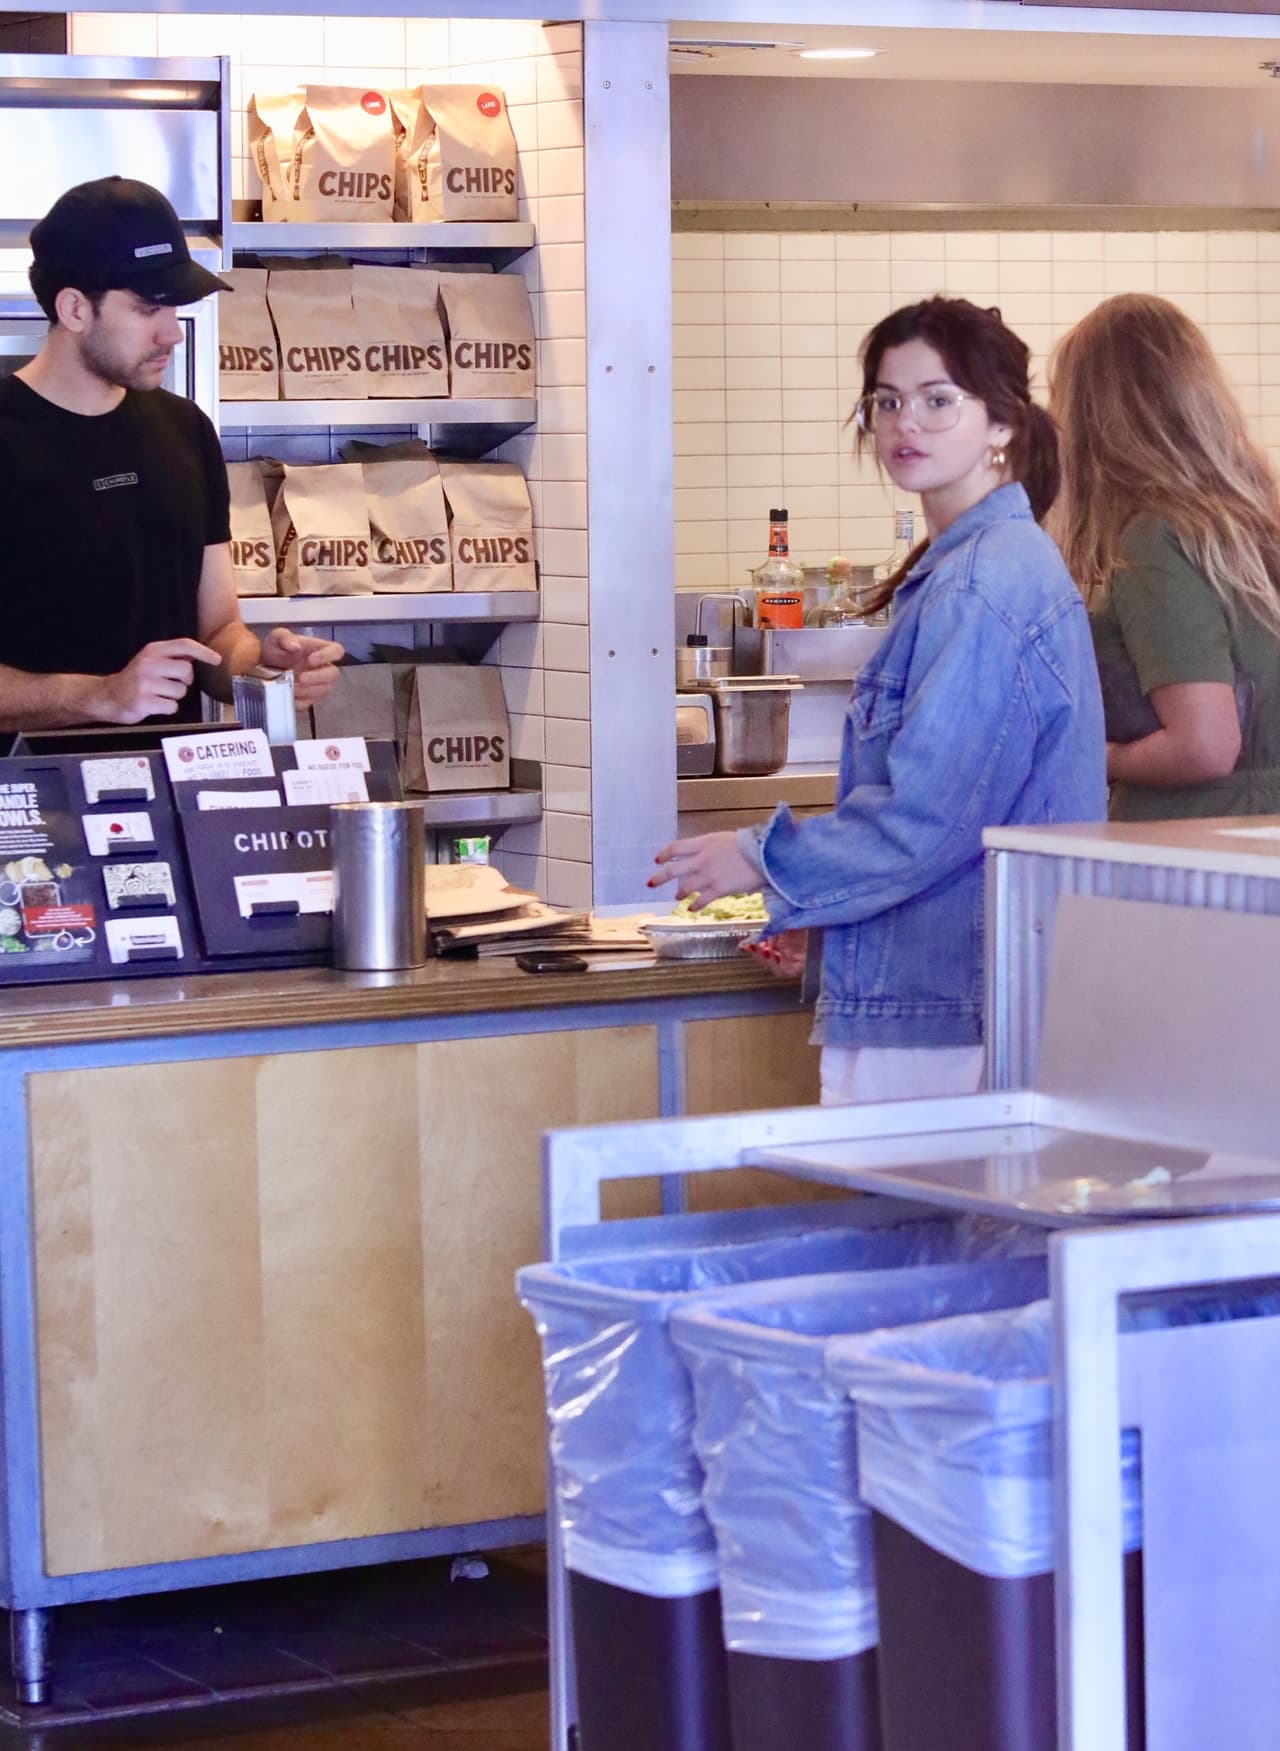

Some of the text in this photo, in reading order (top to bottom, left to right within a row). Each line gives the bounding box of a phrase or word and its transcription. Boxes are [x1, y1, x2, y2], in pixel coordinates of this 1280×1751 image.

[318, 171, 392, 200] CHIPS
[446, 167, 515, 195] CHIPS
[219, 345, 274, 372] HIPS
[287, 345, 361, 372] CHIPS
[365, 345, 443, 372] CHIPS
[455, 342, 532, 371] CHIPS
[231, 540, 271, 568] IPS
[301, 539, 369, 568] CHIPS
[377, 537, 446, 565] CHIPS
[458, 537, 529, 564] CHIPS
[196, 740, 257, 760] CATERING
[427, 735, 504, 764] CHIPS
[0, 809, 46, 827] OWLS.
[233, 829, 329, 852] CHIPOT
